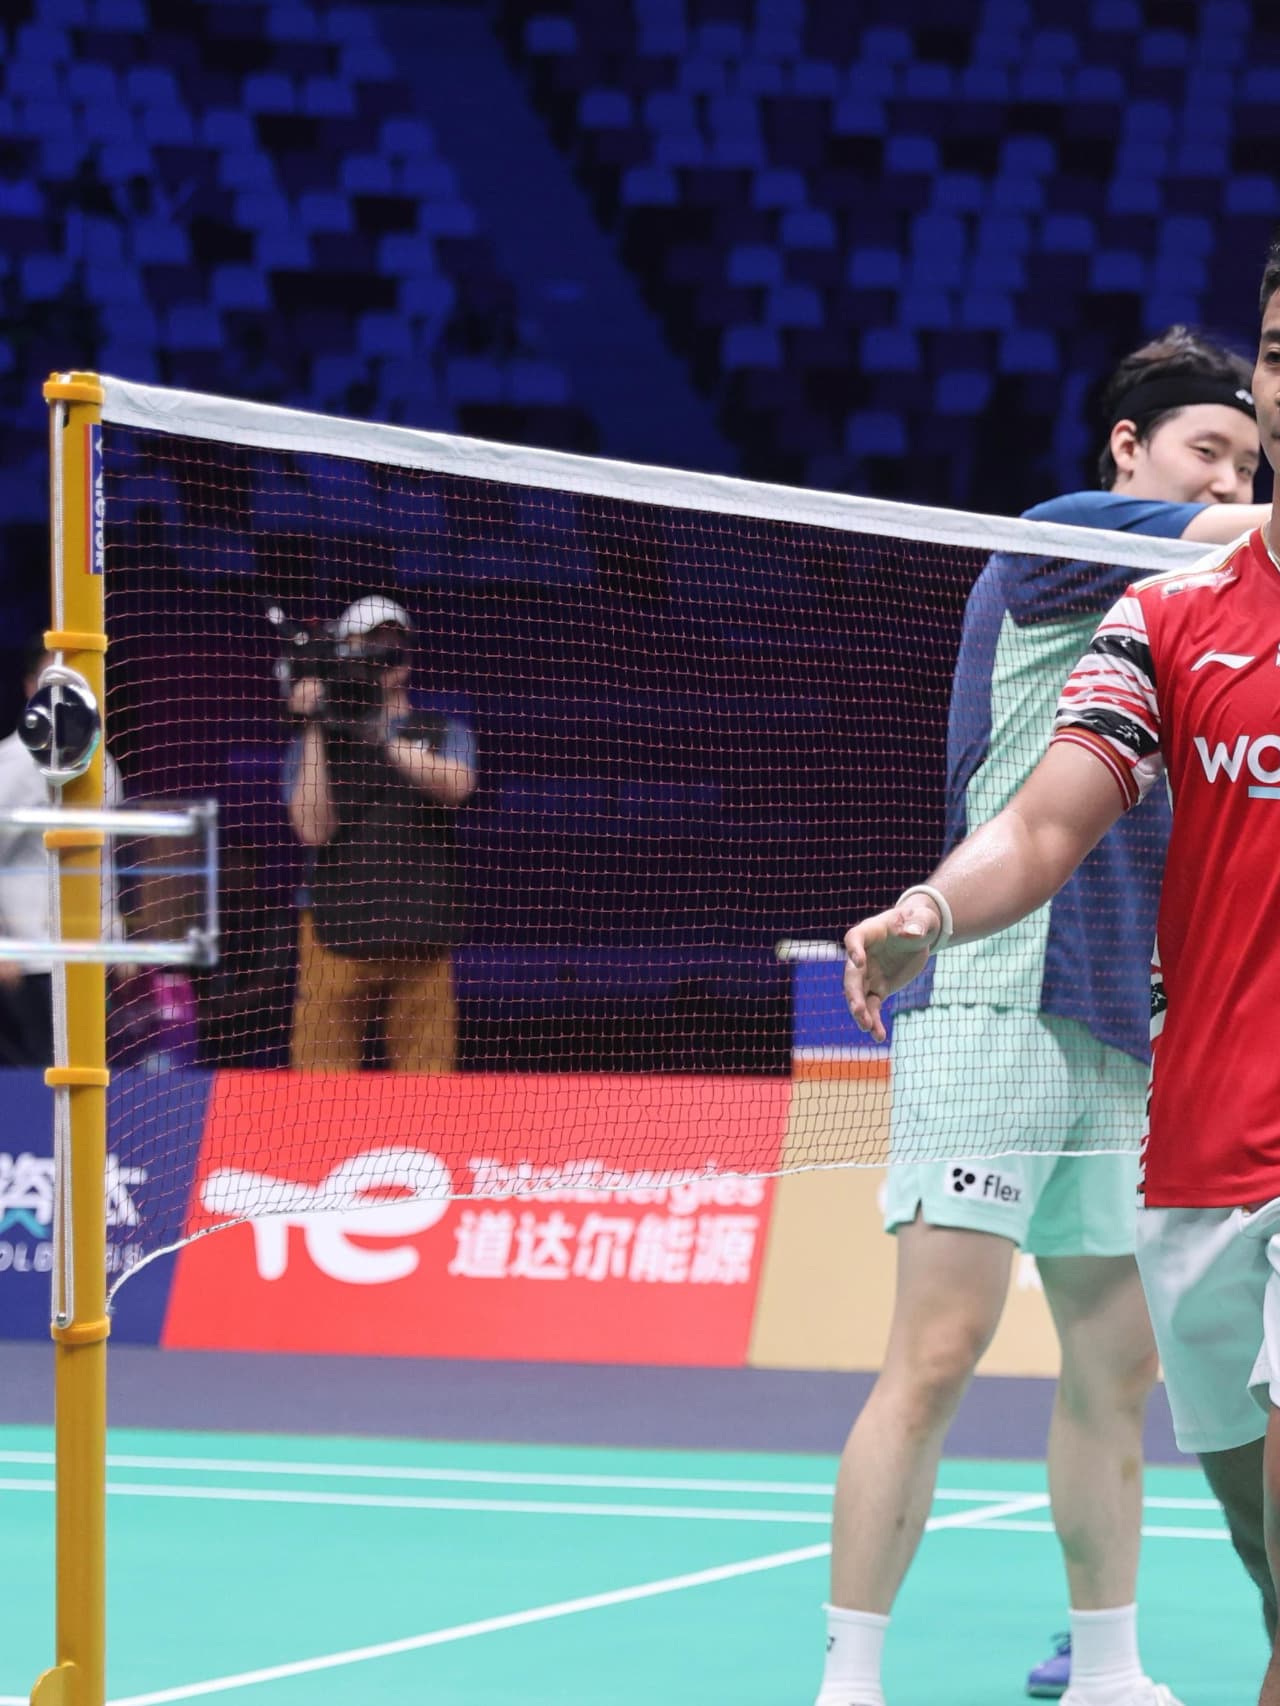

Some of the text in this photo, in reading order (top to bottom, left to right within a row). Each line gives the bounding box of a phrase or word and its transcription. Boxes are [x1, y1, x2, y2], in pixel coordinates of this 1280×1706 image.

[448, 1210, 760, 1284] 道达尔能源
